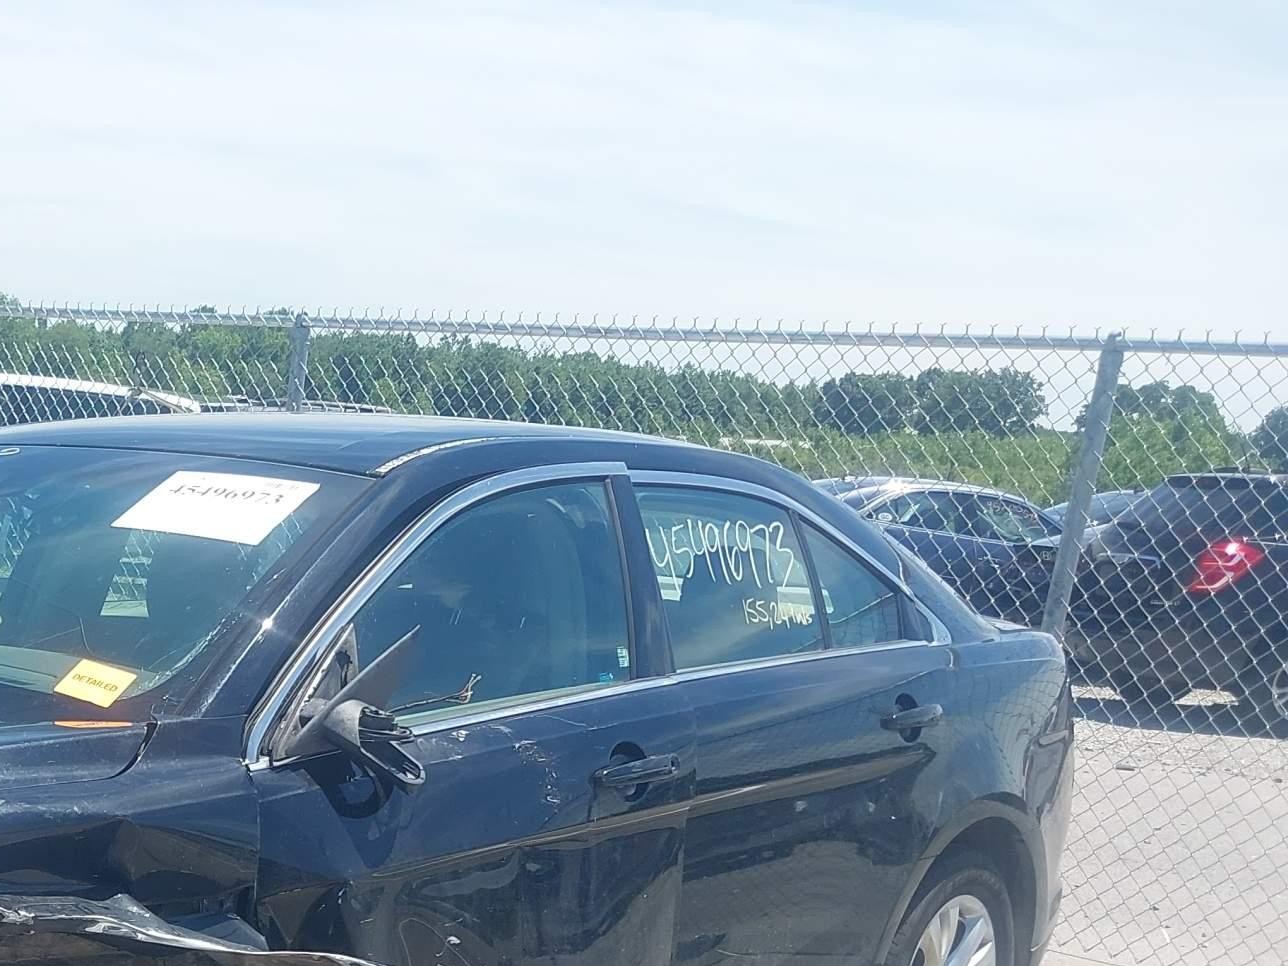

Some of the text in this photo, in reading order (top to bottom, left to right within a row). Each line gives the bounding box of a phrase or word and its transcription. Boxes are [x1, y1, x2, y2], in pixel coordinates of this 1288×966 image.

[169, 484, 284, 505] 45496973
[645, 519, 793, 596] 45496973
[73, 673, 118, 693] DETAILED
